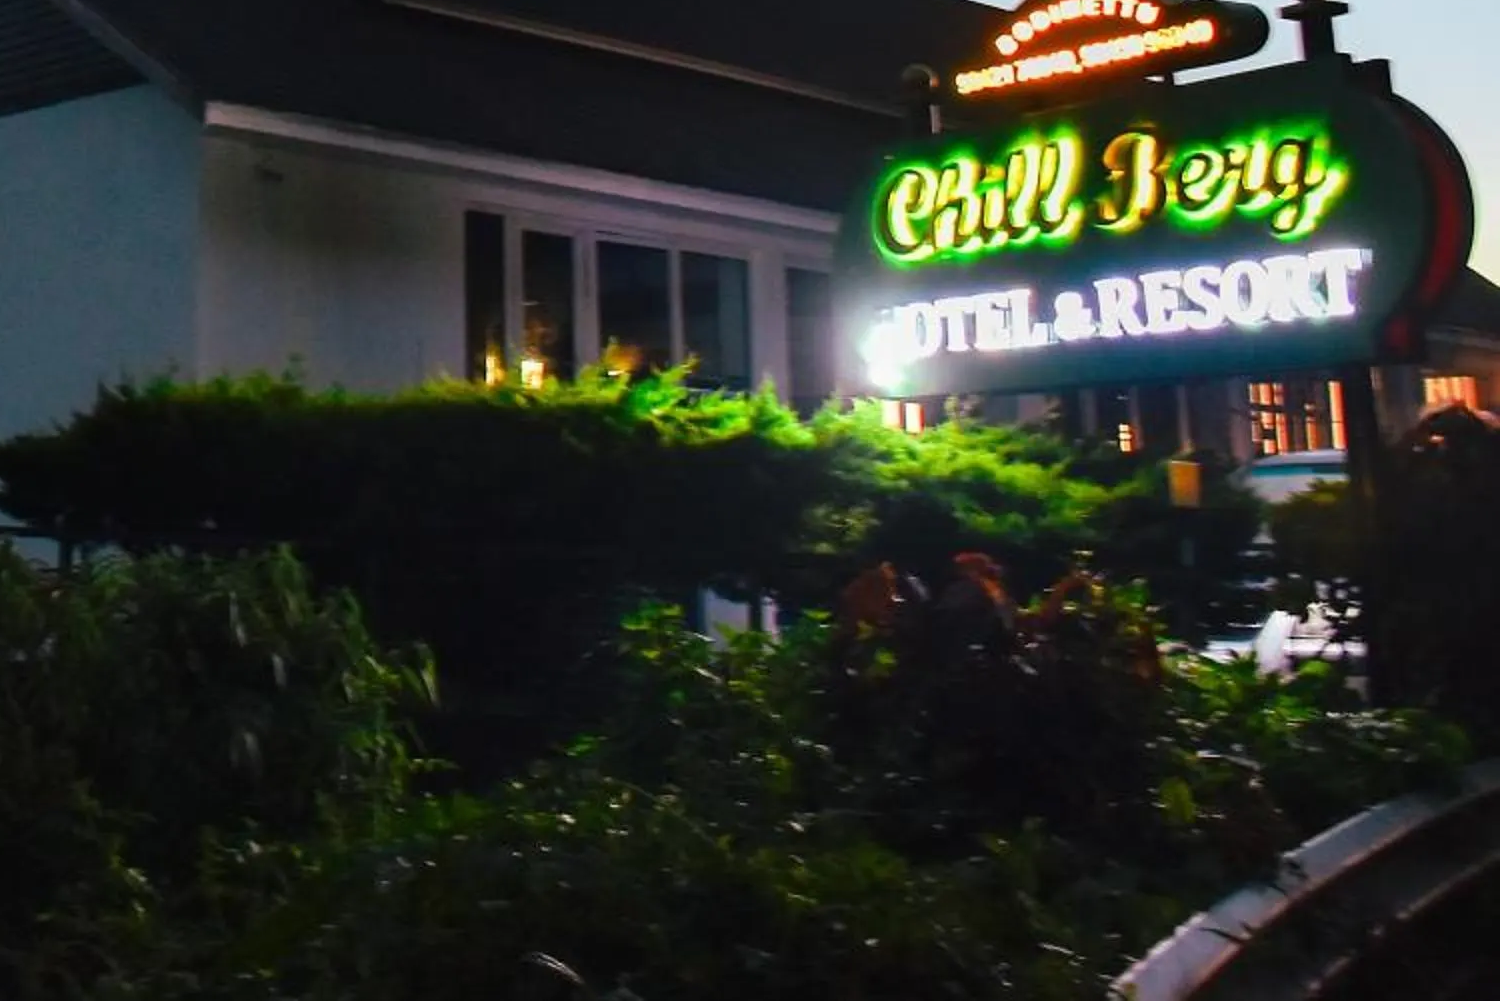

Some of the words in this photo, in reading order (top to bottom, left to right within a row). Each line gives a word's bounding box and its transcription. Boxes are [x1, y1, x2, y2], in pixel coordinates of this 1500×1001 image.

[874, 137, 1085, 263] Chill
[870, 287, 1051, 361] OTEL
[1095, 248, 1368, 338] RESORT
